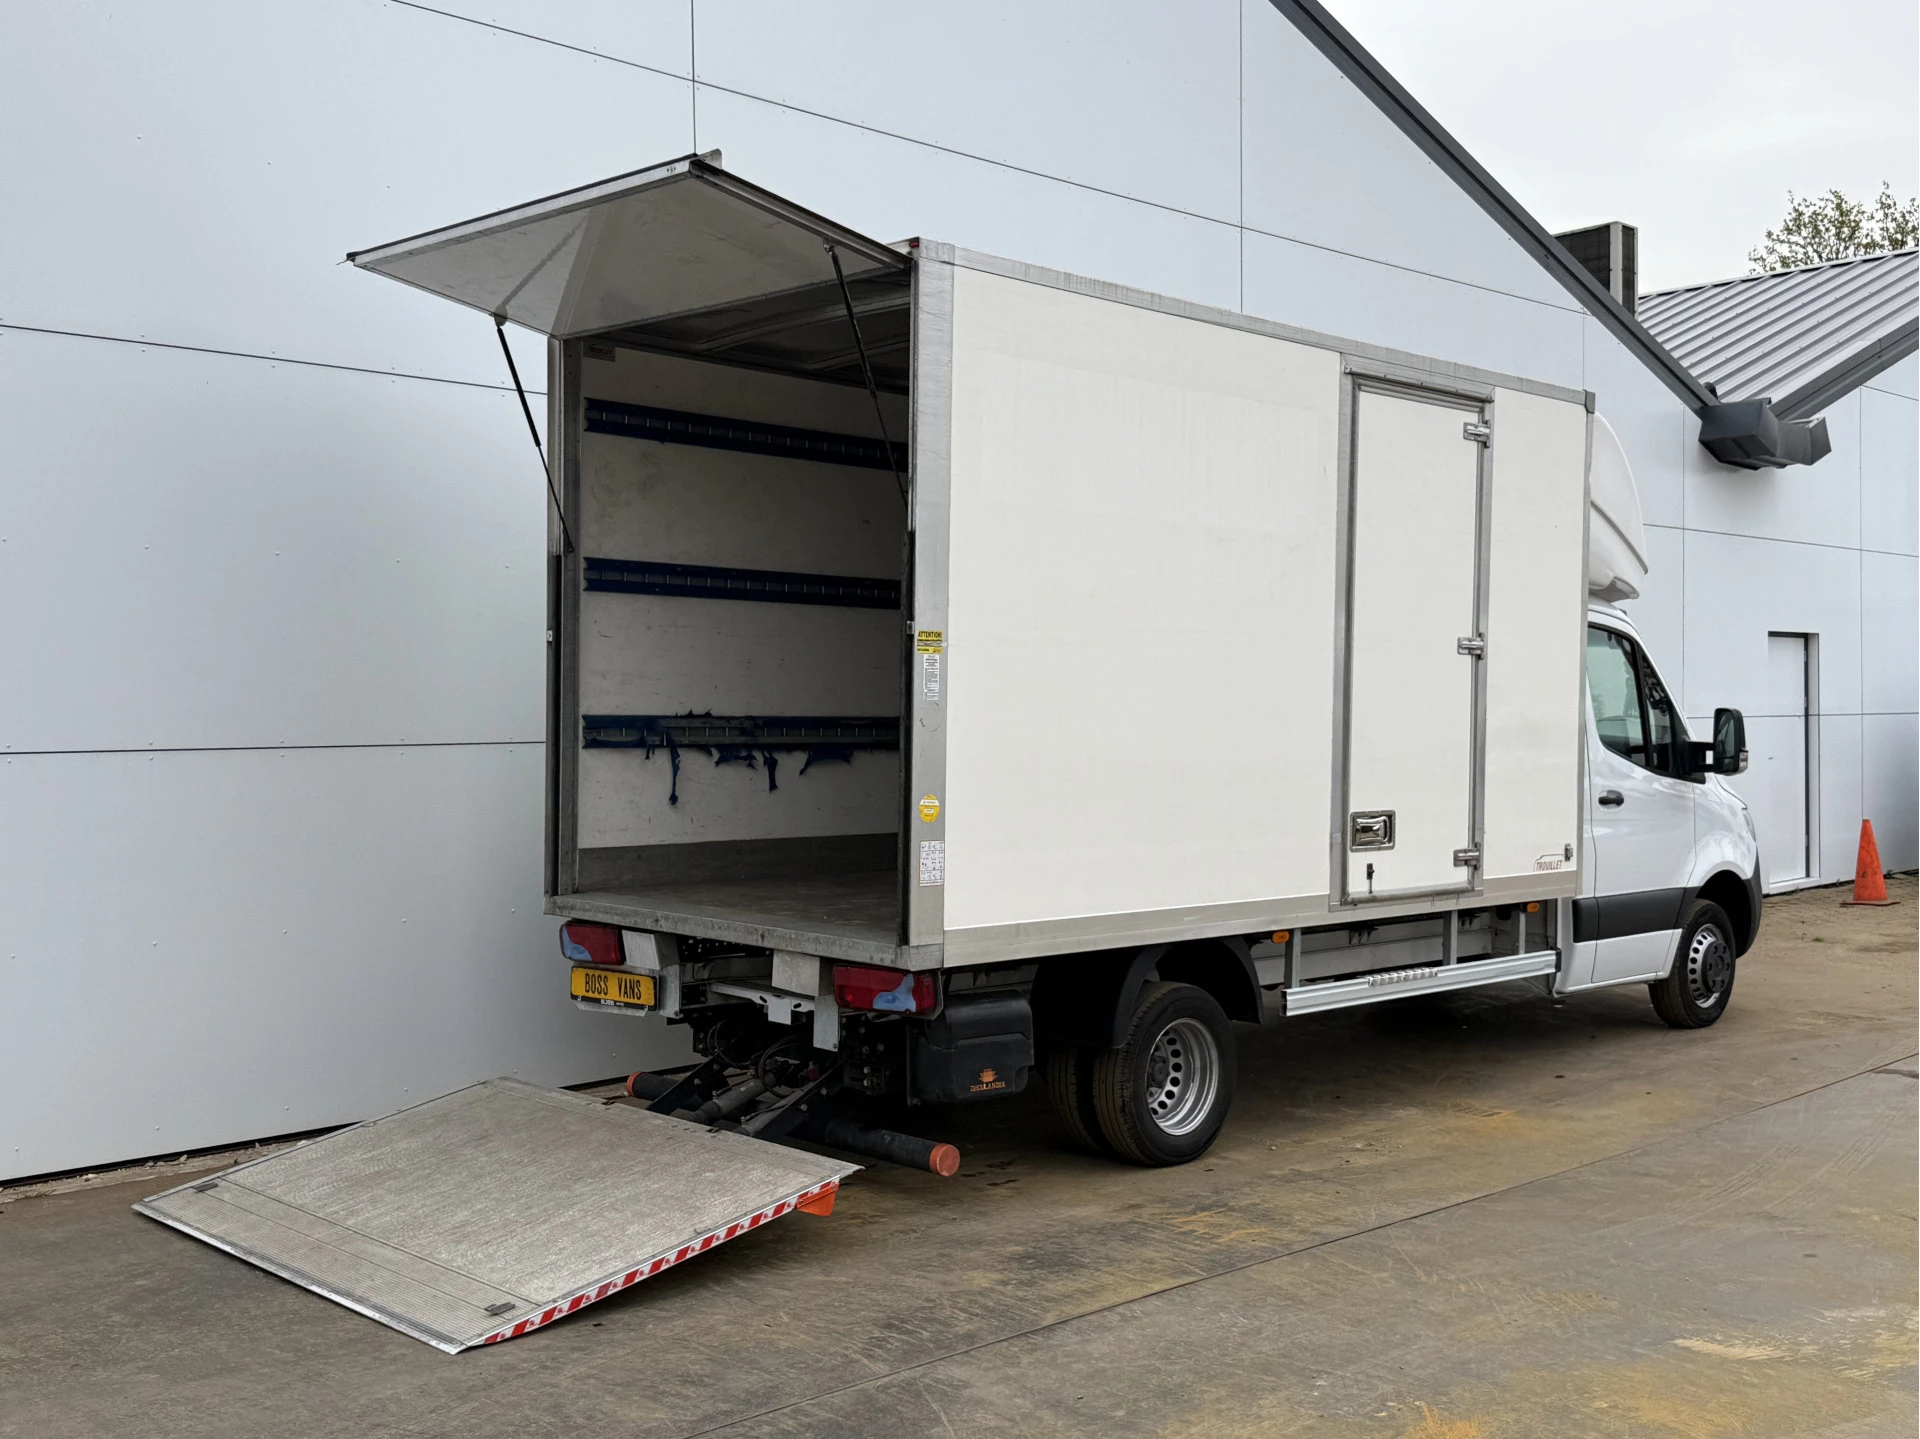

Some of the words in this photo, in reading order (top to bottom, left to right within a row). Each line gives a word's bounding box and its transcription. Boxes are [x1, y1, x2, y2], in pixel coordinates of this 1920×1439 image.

[1535, 860, 1563, 871] TROUILLET
[585, 973, 608, 996] BOSS
[617, 977, 641, 1000] VANS
